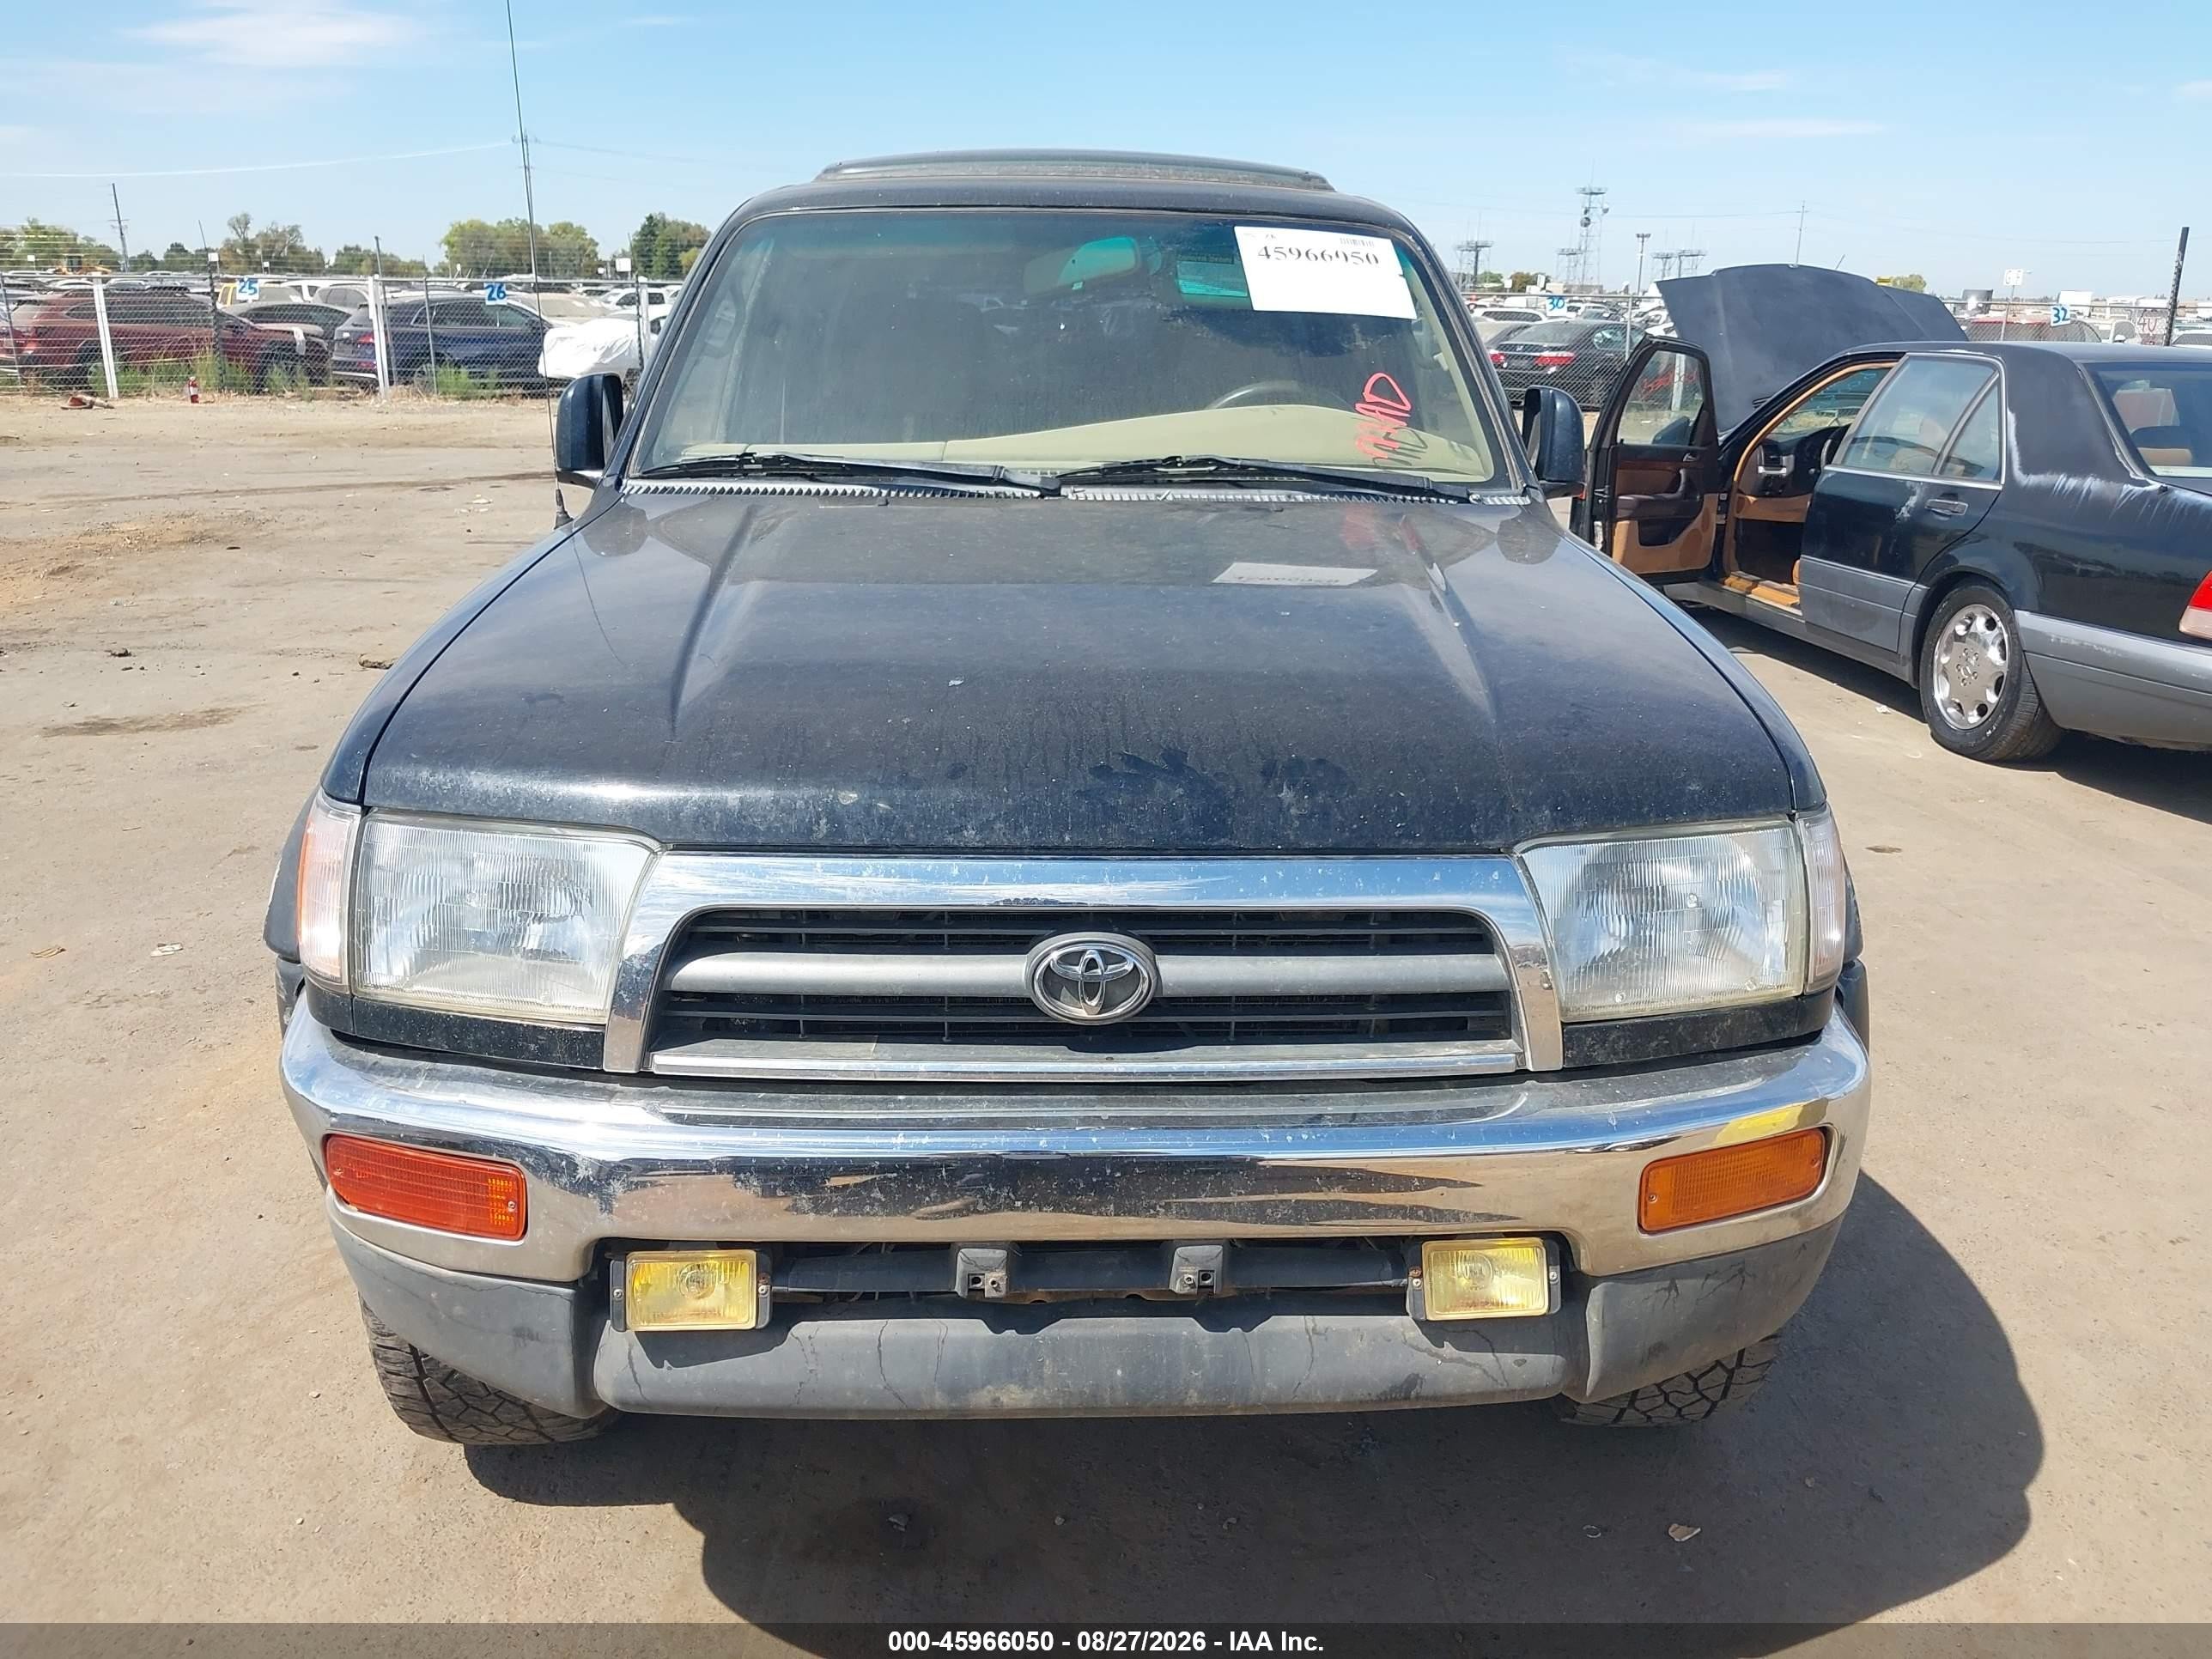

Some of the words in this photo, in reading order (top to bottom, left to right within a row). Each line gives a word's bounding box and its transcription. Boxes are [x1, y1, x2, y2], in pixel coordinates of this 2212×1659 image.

[238, 277, 258, 295] 25
[484, 282, 507, 301] 26
[1547, 295, 1565, 311] 30
[2052, 307, 2070, 324] 32
